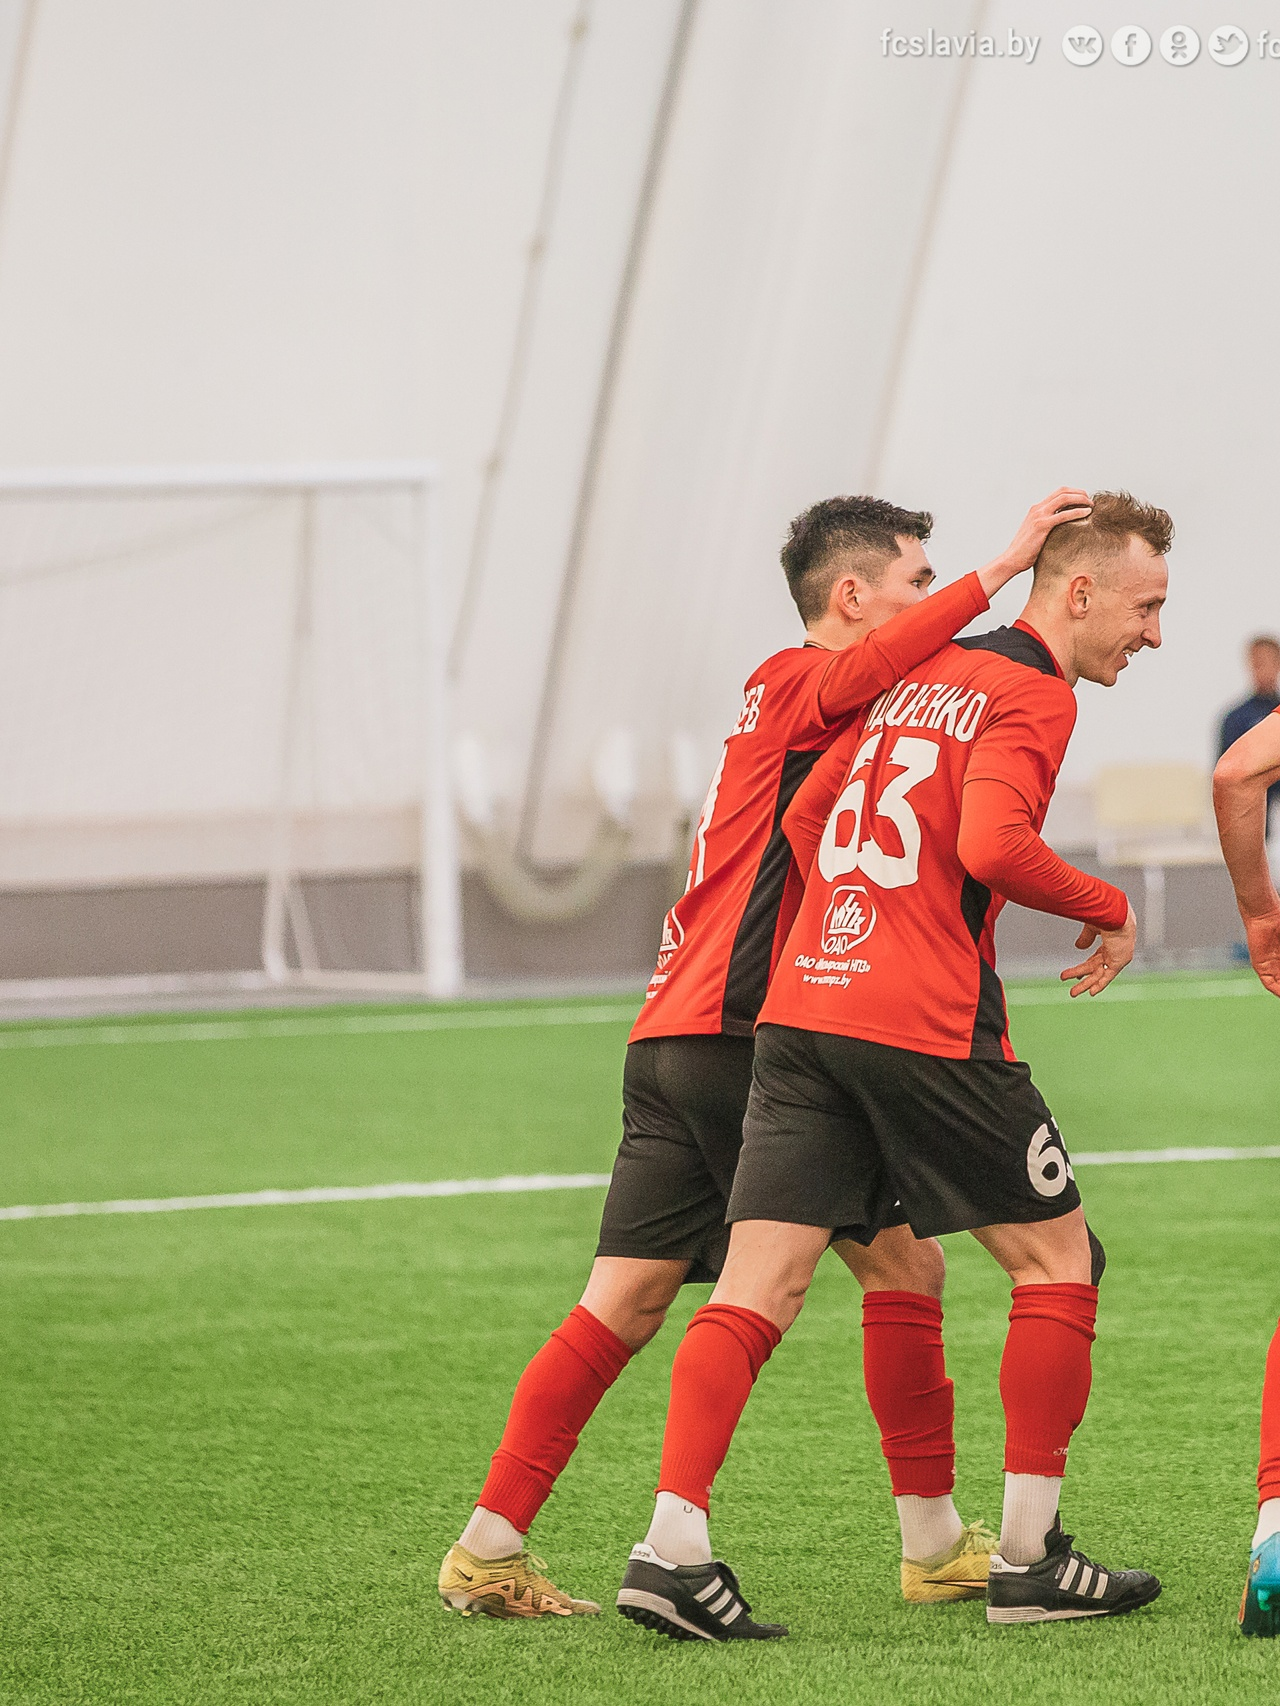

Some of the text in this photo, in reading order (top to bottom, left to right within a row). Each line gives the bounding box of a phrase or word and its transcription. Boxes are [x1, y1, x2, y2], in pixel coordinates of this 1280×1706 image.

[818, 731, 940, 889] 63
[795, 955, 816, 969] ОАО
[823, 935, 848, 955] ОАО
[1027, 1114, 1075, 1197] 6
